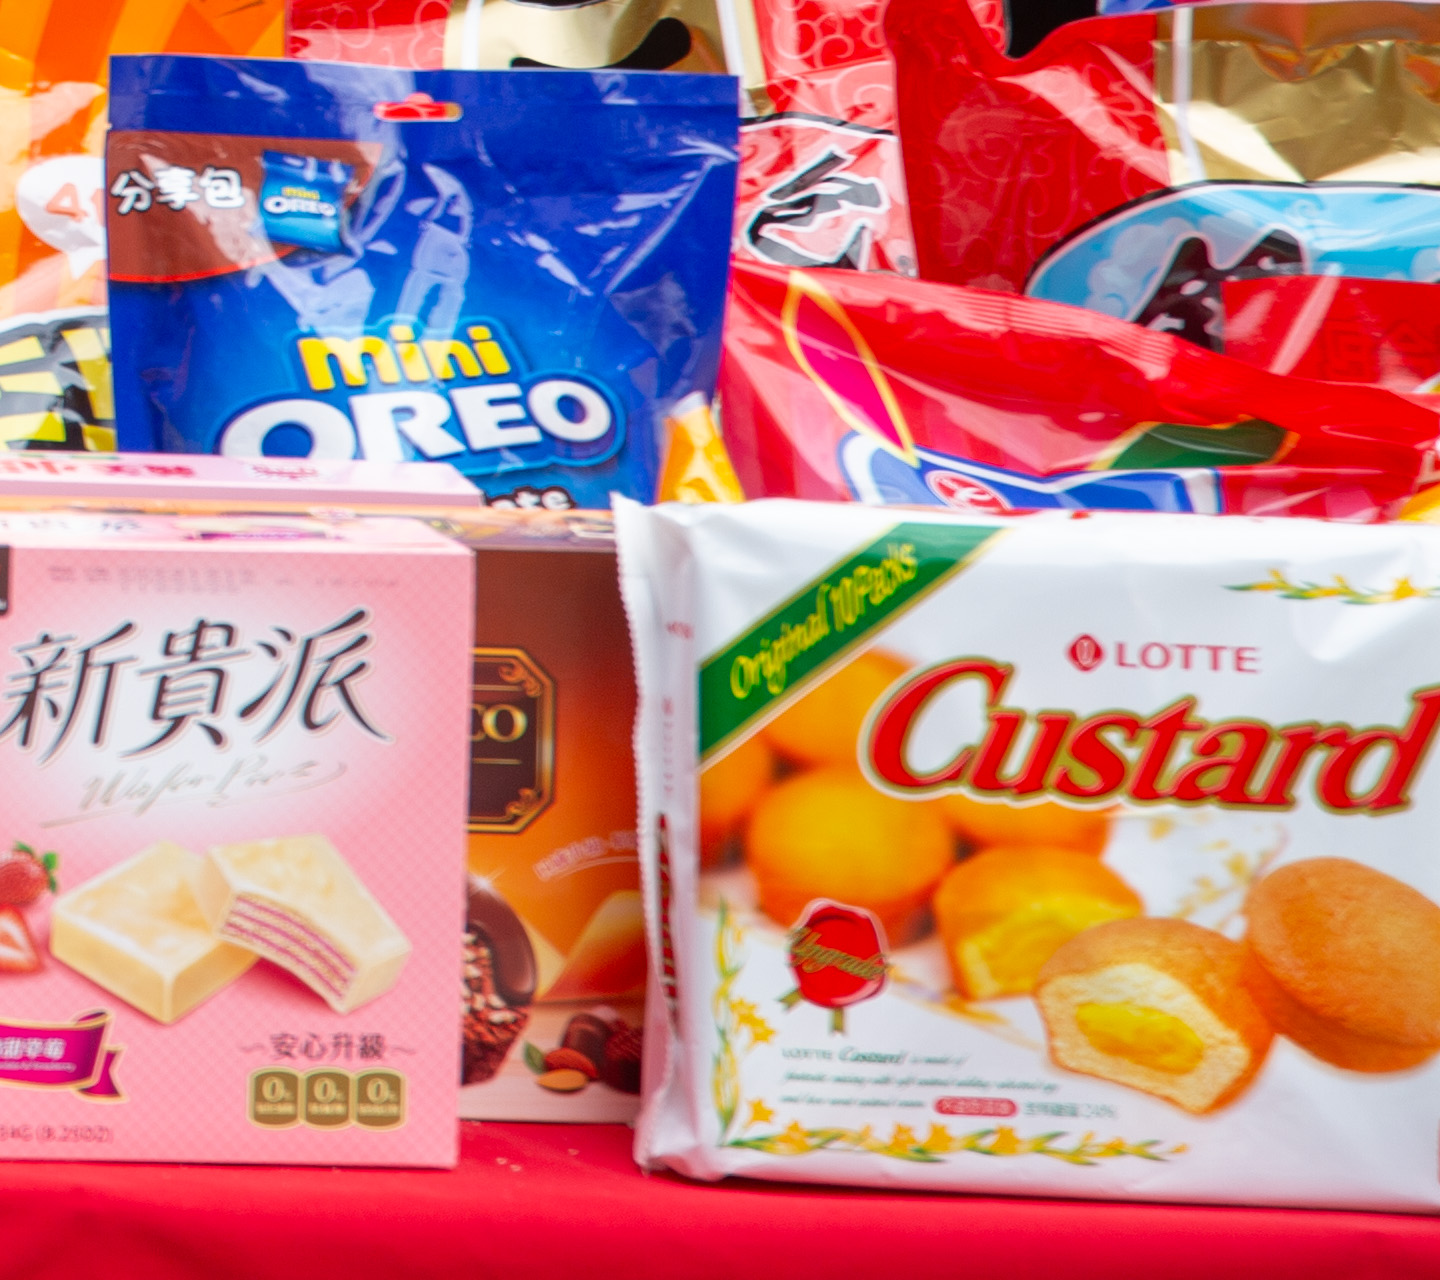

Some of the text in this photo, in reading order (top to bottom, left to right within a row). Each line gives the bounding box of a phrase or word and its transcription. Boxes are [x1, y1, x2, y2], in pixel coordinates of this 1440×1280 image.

[110, 164, 246, 216] 分享包
[262, 196, 336, 217] OREO
[297, 324, 511, 392] mini
[219, 380, 613, 462] OREO
[730, 583, 831, 700] Original
[1115, 641, 1261, 674] LOTTE
[865, 658, 1440, 814] Custard
